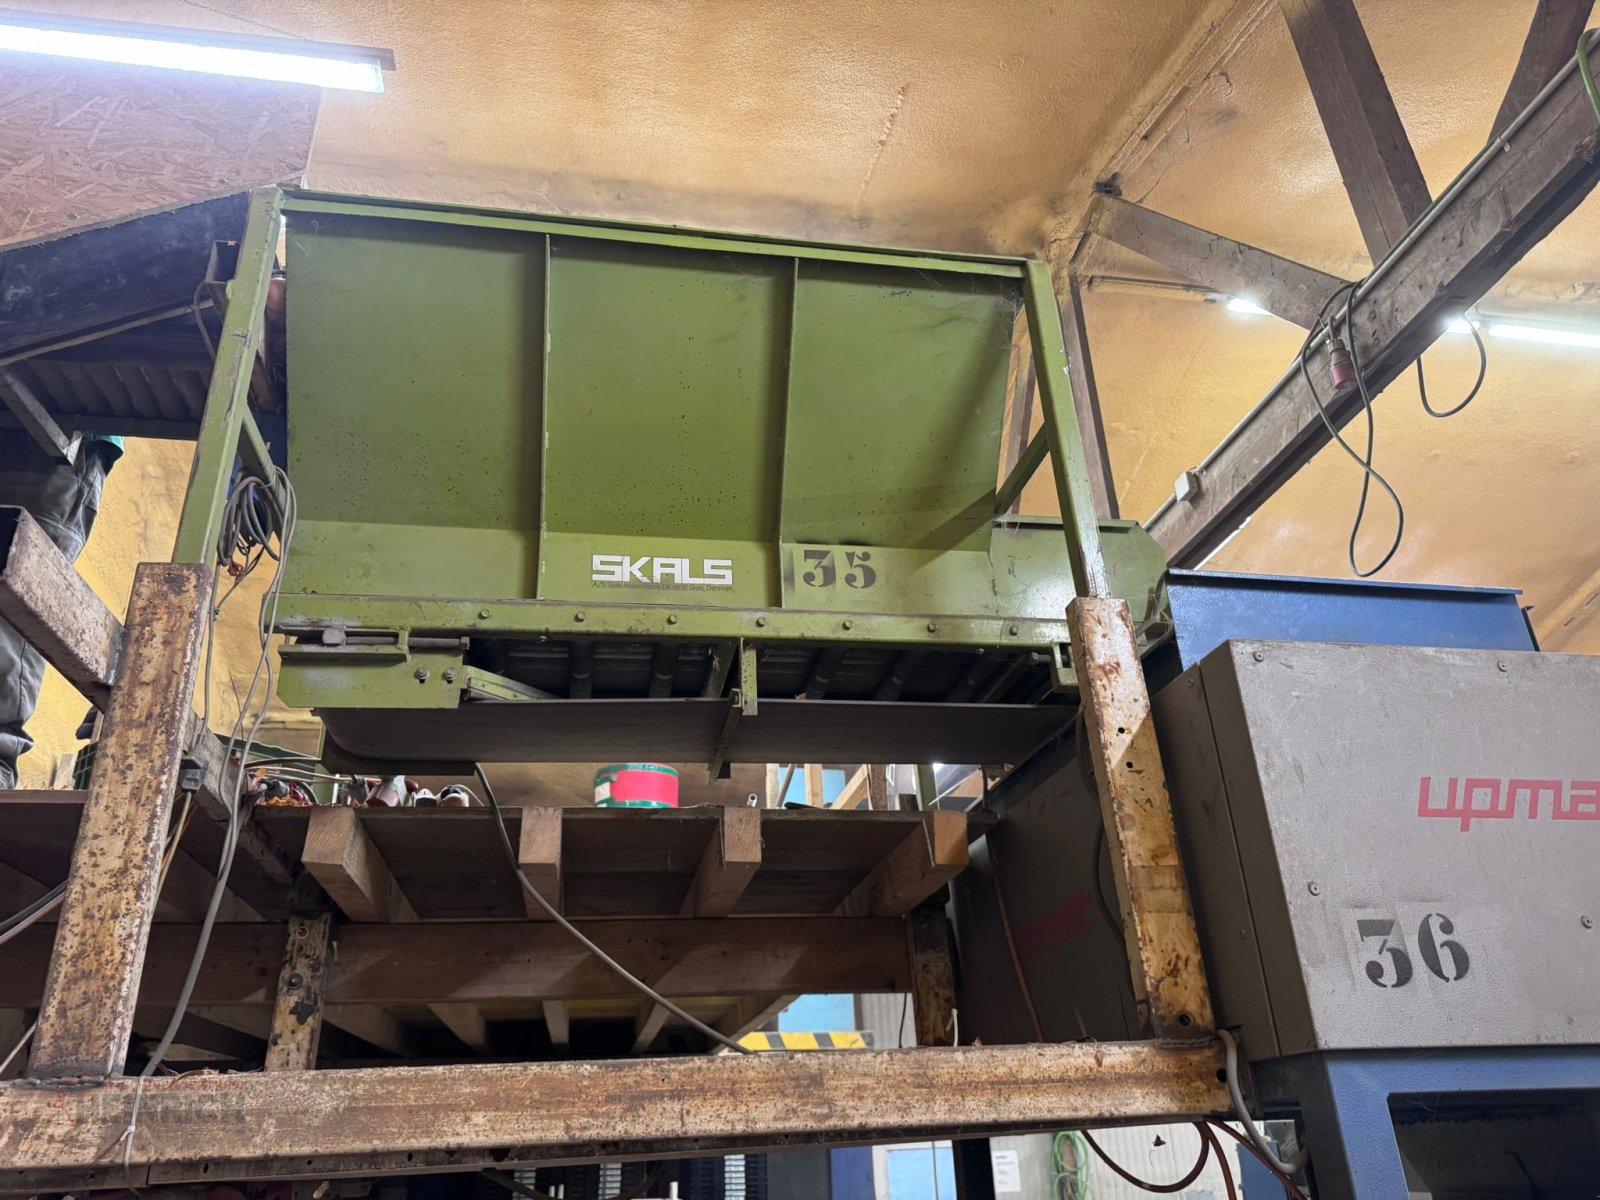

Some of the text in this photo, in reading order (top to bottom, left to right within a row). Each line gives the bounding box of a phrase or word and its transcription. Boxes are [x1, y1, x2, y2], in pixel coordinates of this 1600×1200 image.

[592, 554, 733, 585] SKALS
[802, 549, 878, 589] 35
[1356, 912, 1470, 988] 36
